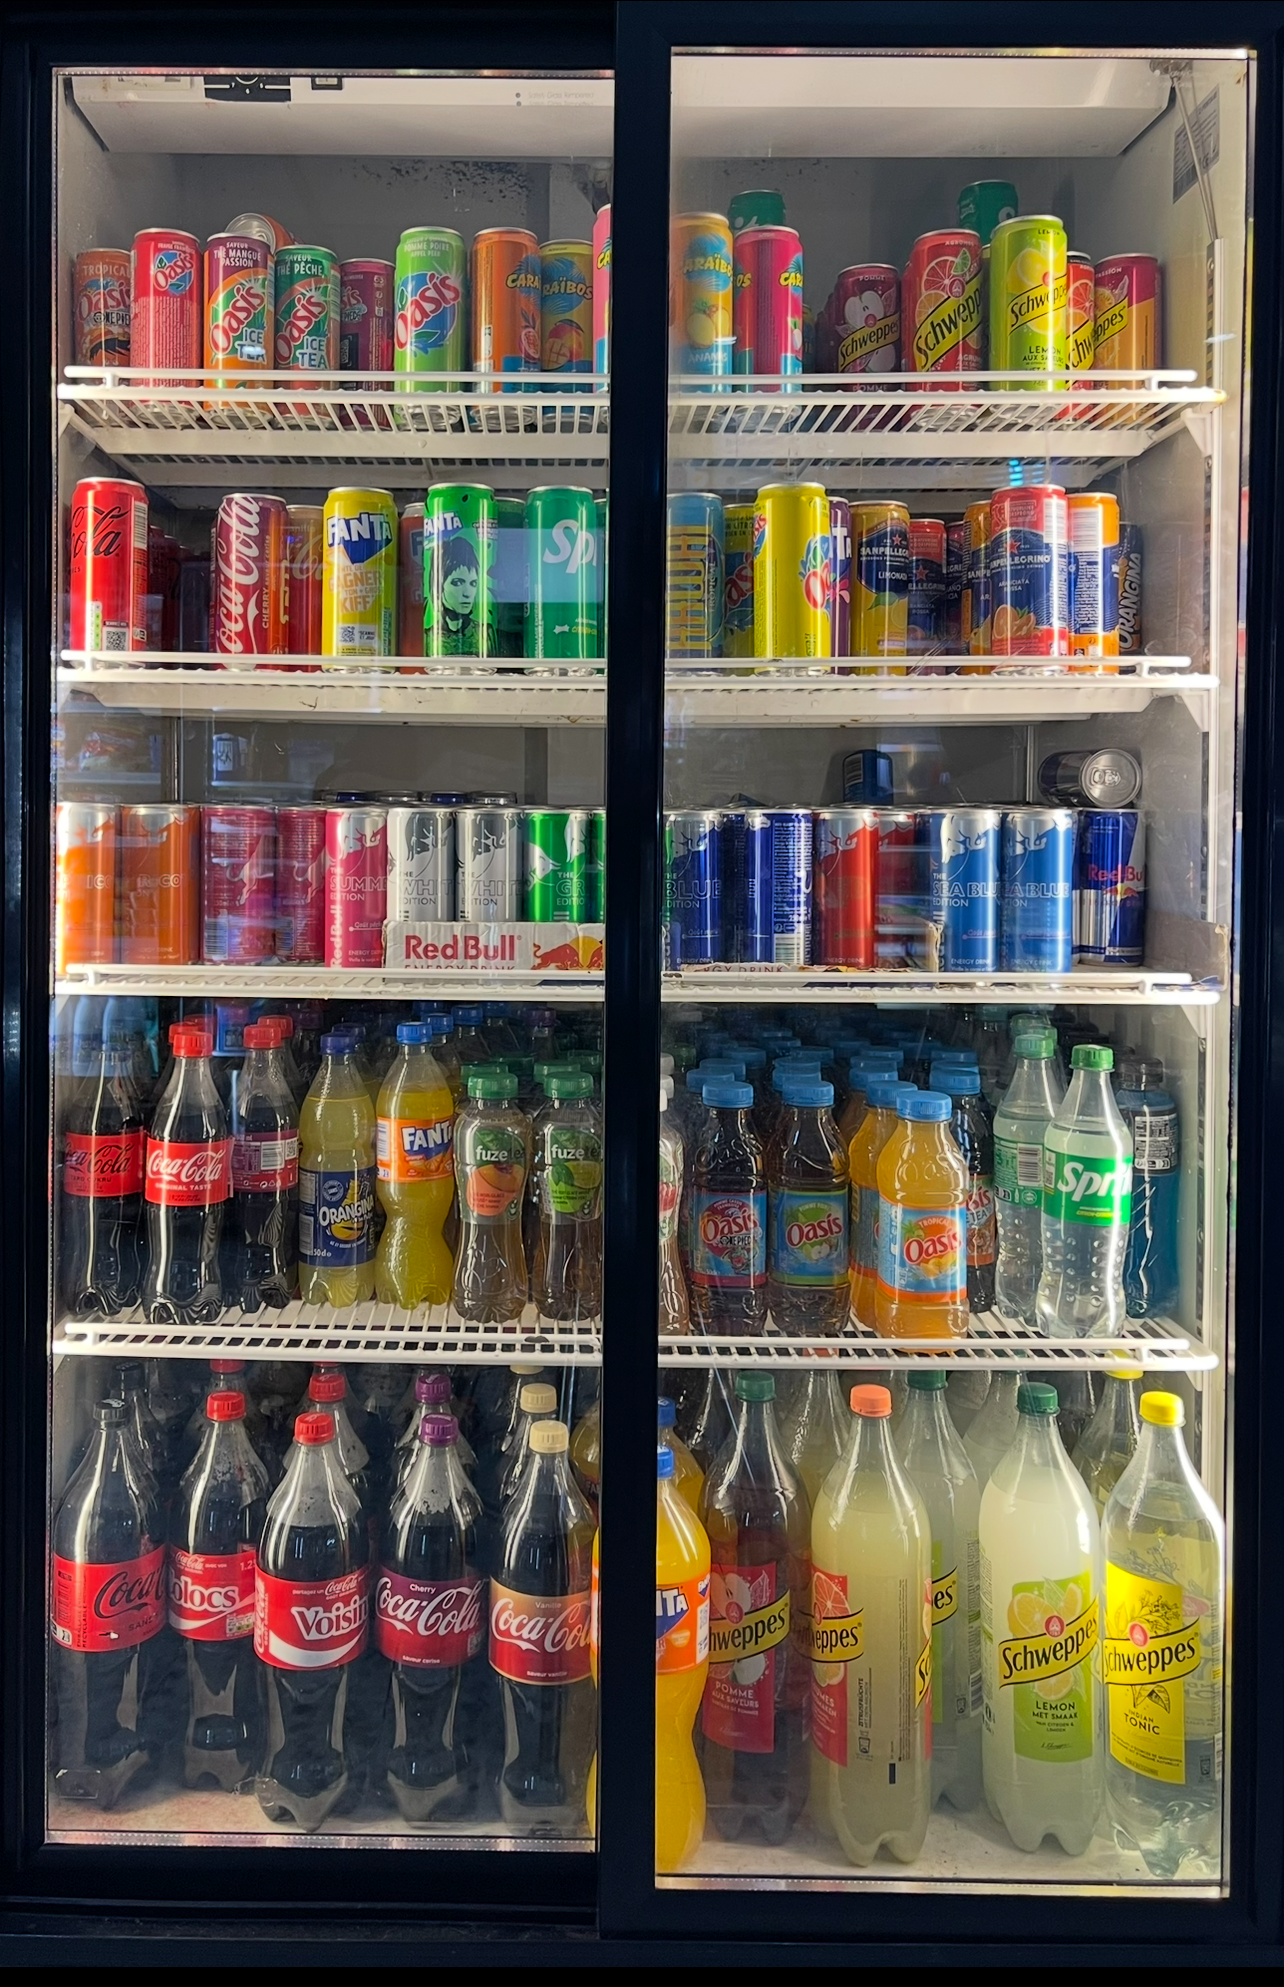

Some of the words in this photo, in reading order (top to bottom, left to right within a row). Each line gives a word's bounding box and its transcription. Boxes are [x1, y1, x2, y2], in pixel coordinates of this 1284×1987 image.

[226, 241, 249, 249] SAVEUR
[221, 257, 254, 268] PASSION
[228, 248, 262, 262] MANGUE
[154, 251, 195, 291] Oasis
[210, 284, 266, 355] Oasis
[395, 271, 461, 351] Oasis
[244, 328, 264, 345] ICE
[275, 292, 328, 365] Oasis
[238, 344, 267, 363] TEA
[304, 336, 326, 352] ICE
[299, 351, 328, 370] TEA
[327, 510, 393, 550] FANTA
[262, 586, 270, 629] CHERRY
[341, 595, 371, 614] KIFF
[1118, 552, 1142, 650] ORANGINA
[557, 871, 575, 879] THE
[932, 872, 947, 880] THE
[932, 881, 965, 897] SEA
[1025, 883, 1070, 899] BLUE
[403, 897, 437, 906] DITION
[666, 900, 700, 909] DITION
[932, 898, 969, 907] EDITION
[330, 904, 343, 936] Bull
[330, 936, 343, 968] Red
[405, 934, 459, 961] Red
[463, 934, 515, 961] Bull
[147, 1149, 227, 1184] Coca-Cola
[155, 1182, 187, 1191] ORIGINAL
[189, 1182, 212, 1191] TASTE
[319, 1194, 375, 1227] ORANGINA
[702, 1207, 760, 1243] Oasis
[786, 1212, 844, 1249] Oasis
[903, 1228, 964, 1266] Oasis
[409, 1583, 437, 1595] Cherry
[376, 1576, 486, 1636] Coca-Cola
[534, 1600, 562, 1609] Vanille
[709, 1607, 786, 1653] hweppes
[1002, 1615, 1098, 1681] Schweppes
[402, 1655, 421, 1663] saveur
[526, 1670, 547, 1678] saveur
[712, 1690, 725, 1701] AUX
[726, 1695, 760, 1709] SAVEURS
[715, 1681, 755, 1699] POMME
[1032, 1710, 1050, 1720] MET
[1051, 1711, 1079, 1721] SMAAK
[1035, 1701, 1076, 1712] LEMON
[1128, 1708, 1155, 1724] INDIAN
[1124, 1713, 1161, 1736] TONIC
